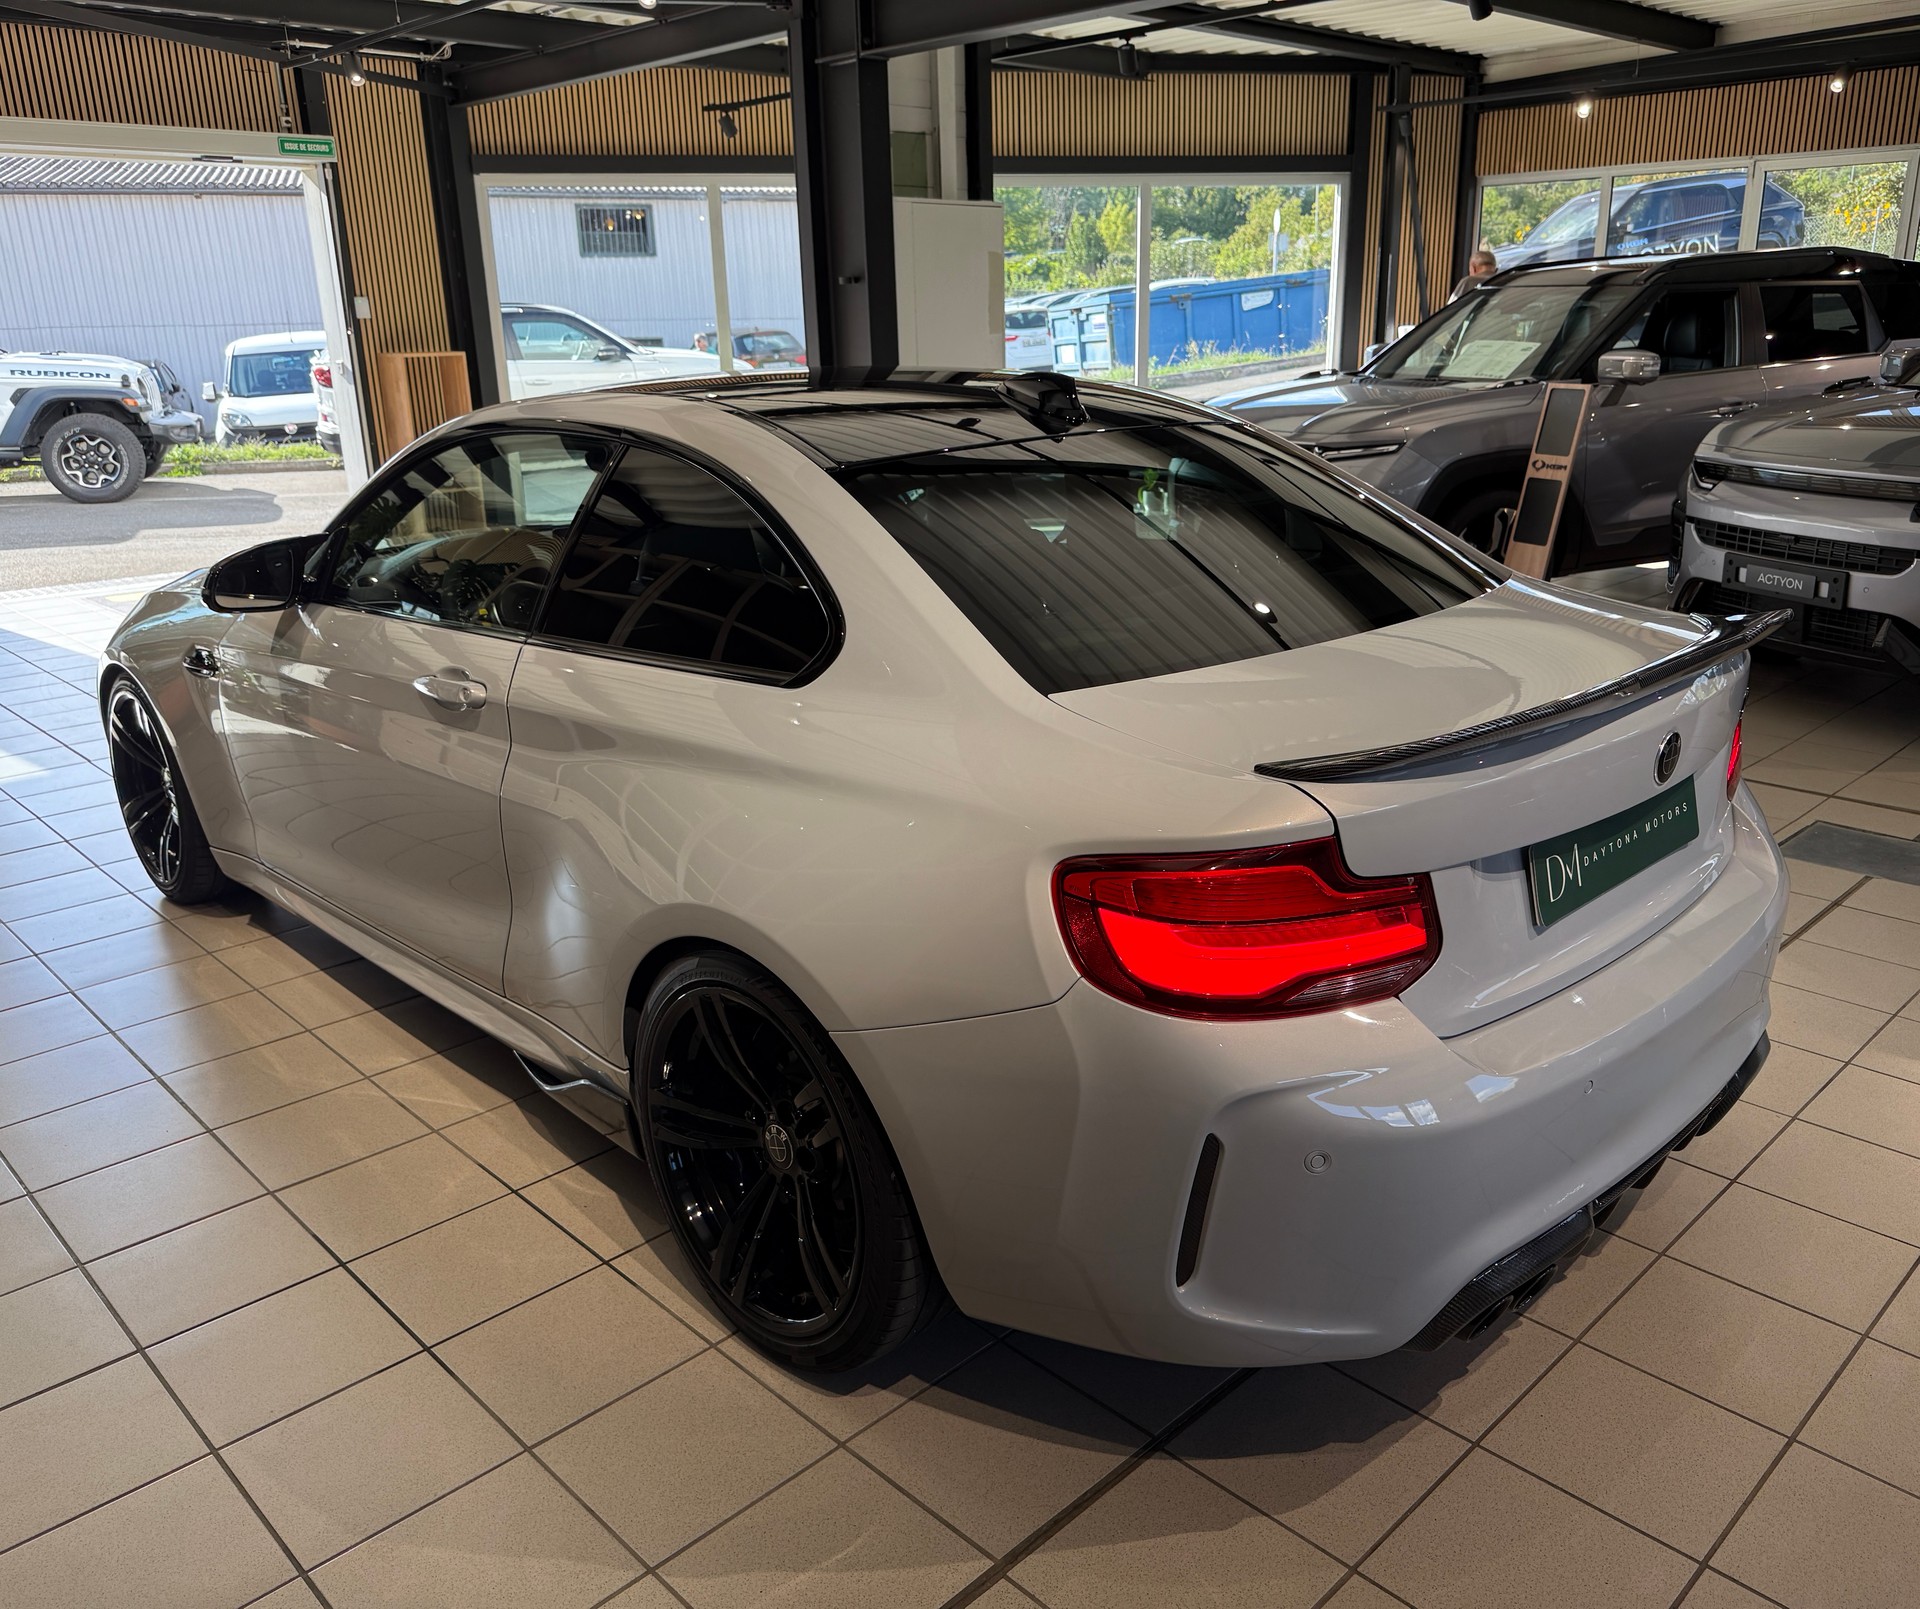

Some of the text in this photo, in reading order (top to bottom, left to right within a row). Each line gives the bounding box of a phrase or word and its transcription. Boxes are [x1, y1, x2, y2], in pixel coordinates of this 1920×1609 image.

[284, 142, 329, 152] ISSUE DE SECOURS
[1628, 234, 1719, 255] TYON
[9, 369, 111, 378] RUBICON
[1757, 572, 1803, 591] ACTYON
[1584, 802, 1688, 867] DAYTONA MOTORS
